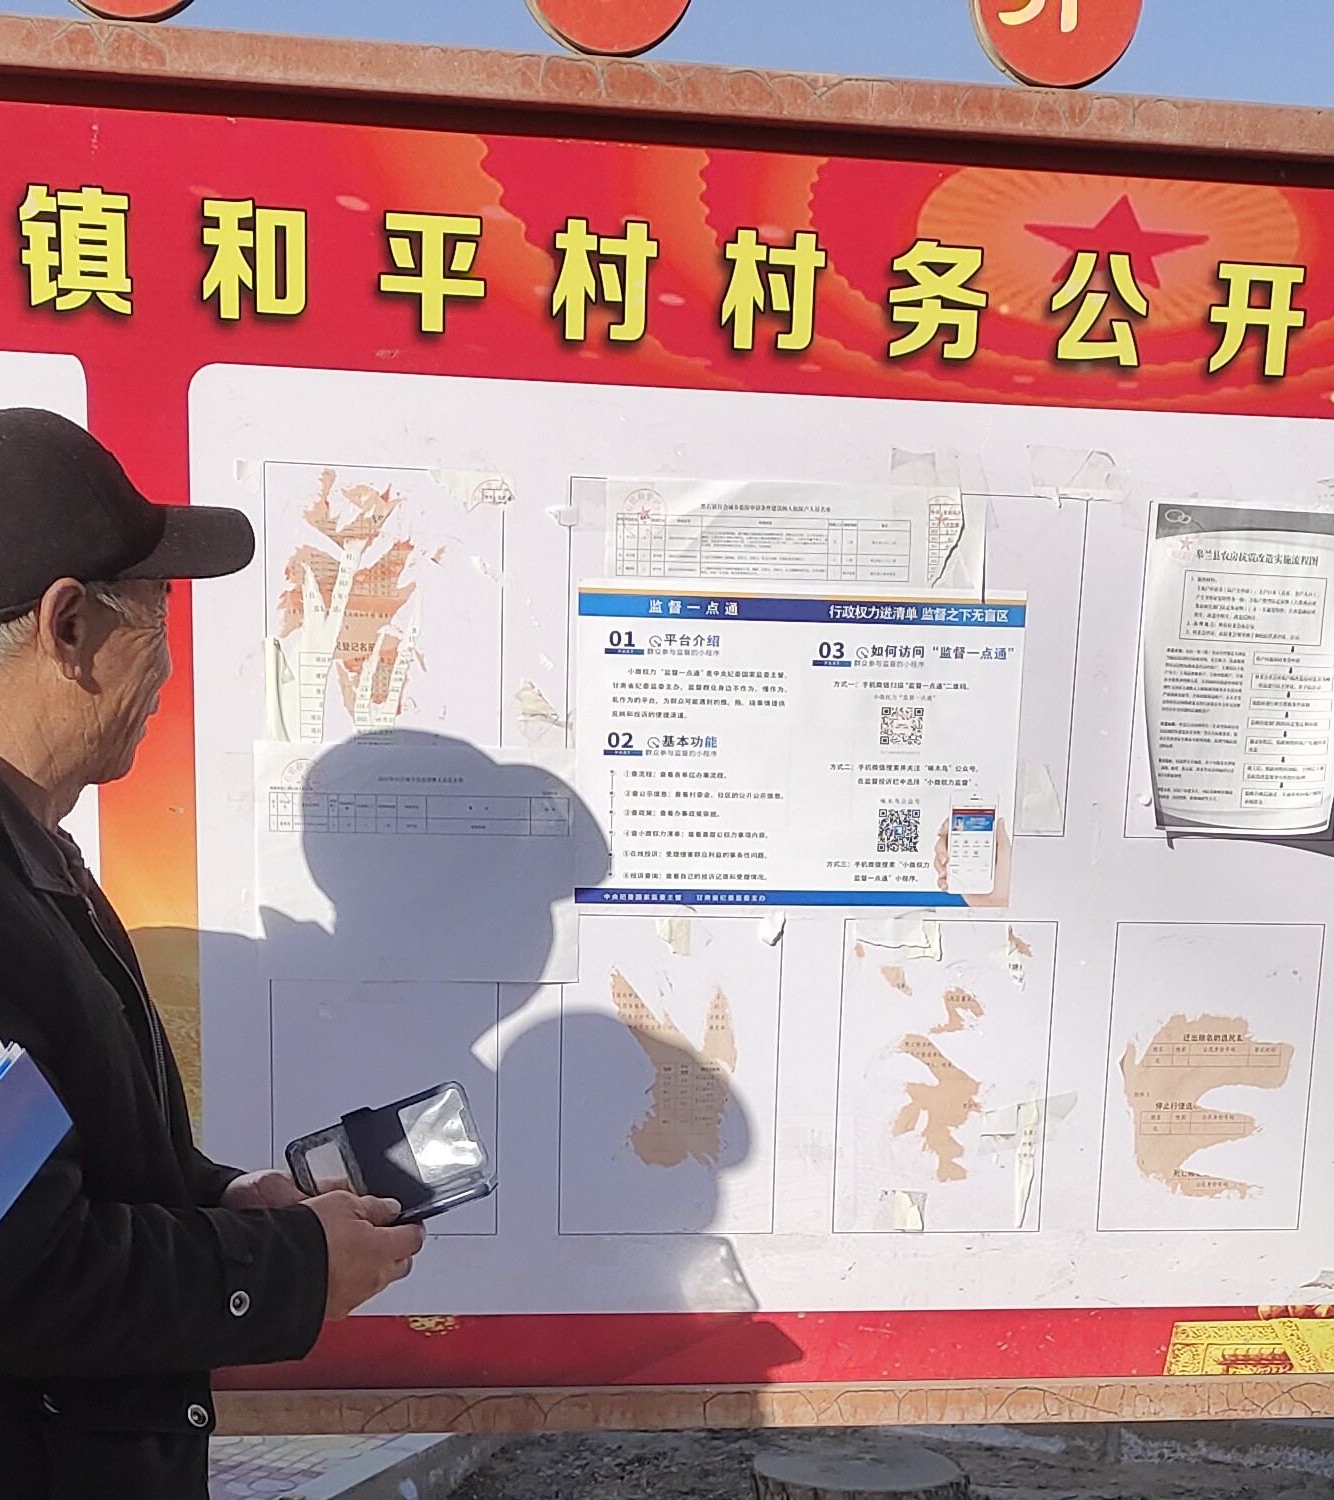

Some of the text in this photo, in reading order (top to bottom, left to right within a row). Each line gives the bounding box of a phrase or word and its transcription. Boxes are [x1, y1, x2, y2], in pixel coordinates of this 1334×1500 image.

[648, 599, 739, 616] 监督一点通
[828, 605, 1009, 623] 行政权力进清单 监督之下无盲区
[608, 630, 635, 648] 01
[663, 633, 720, 648] 平台介绍
[818, 641, 845, 660] 03
[607, 731, 634, 749] 02
[661, 735, 718, 749] 基本功能
